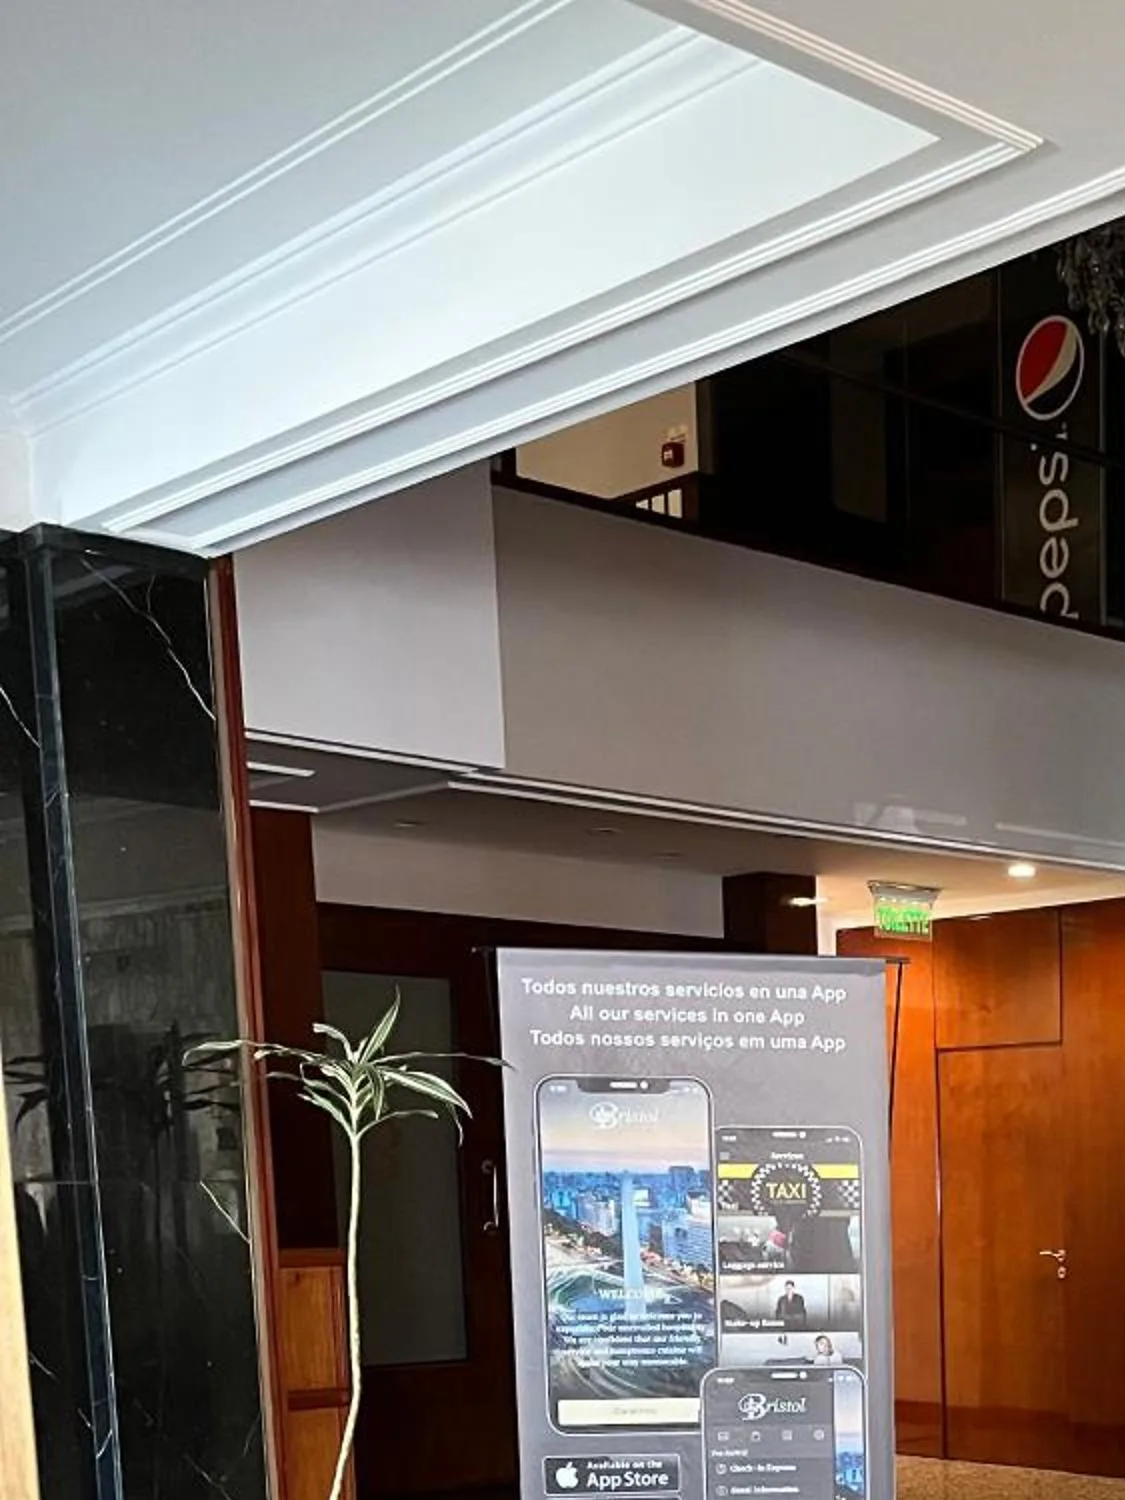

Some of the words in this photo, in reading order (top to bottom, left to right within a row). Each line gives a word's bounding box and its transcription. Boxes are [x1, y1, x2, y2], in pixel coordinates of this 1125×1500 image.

[521, 978, 576, 995] Todos
[582, 981, 660, 997] nuestros
[665, 982, 744, 998] servicios
[750, 986, 770, 999] en
[776, 987, 807, 1000] una
[811, 984, 847, 1004] App
[570, 1005, 593, 1021] All
[599, 1009, 630, 1021] our
[634, 1007, 707, 1023] services
[713, 1007, 728, 1023] in
[733, 1012, 766, 1023] one
[769, 1009, 805, 1027] App
[529, 1029, 585, 1046] Todos
[591, 1034, 656, 1047] nossos
[660, 1031, 734, 1051] serviços
[739, 1036, 765, 1048] em
[770, 1036, 806, 1049] uma
[811, 1035, 846, 1053] App
[766, 1183, 807, 1199] TAXI
[738, 1393, 807, 1420] Bristol
[587, 1461, 630, 1469] Available
[647, 1460, 663, 1469] the
[586, 1472, 622, 1491] App
[623, 1471, 669, 1487] Store
